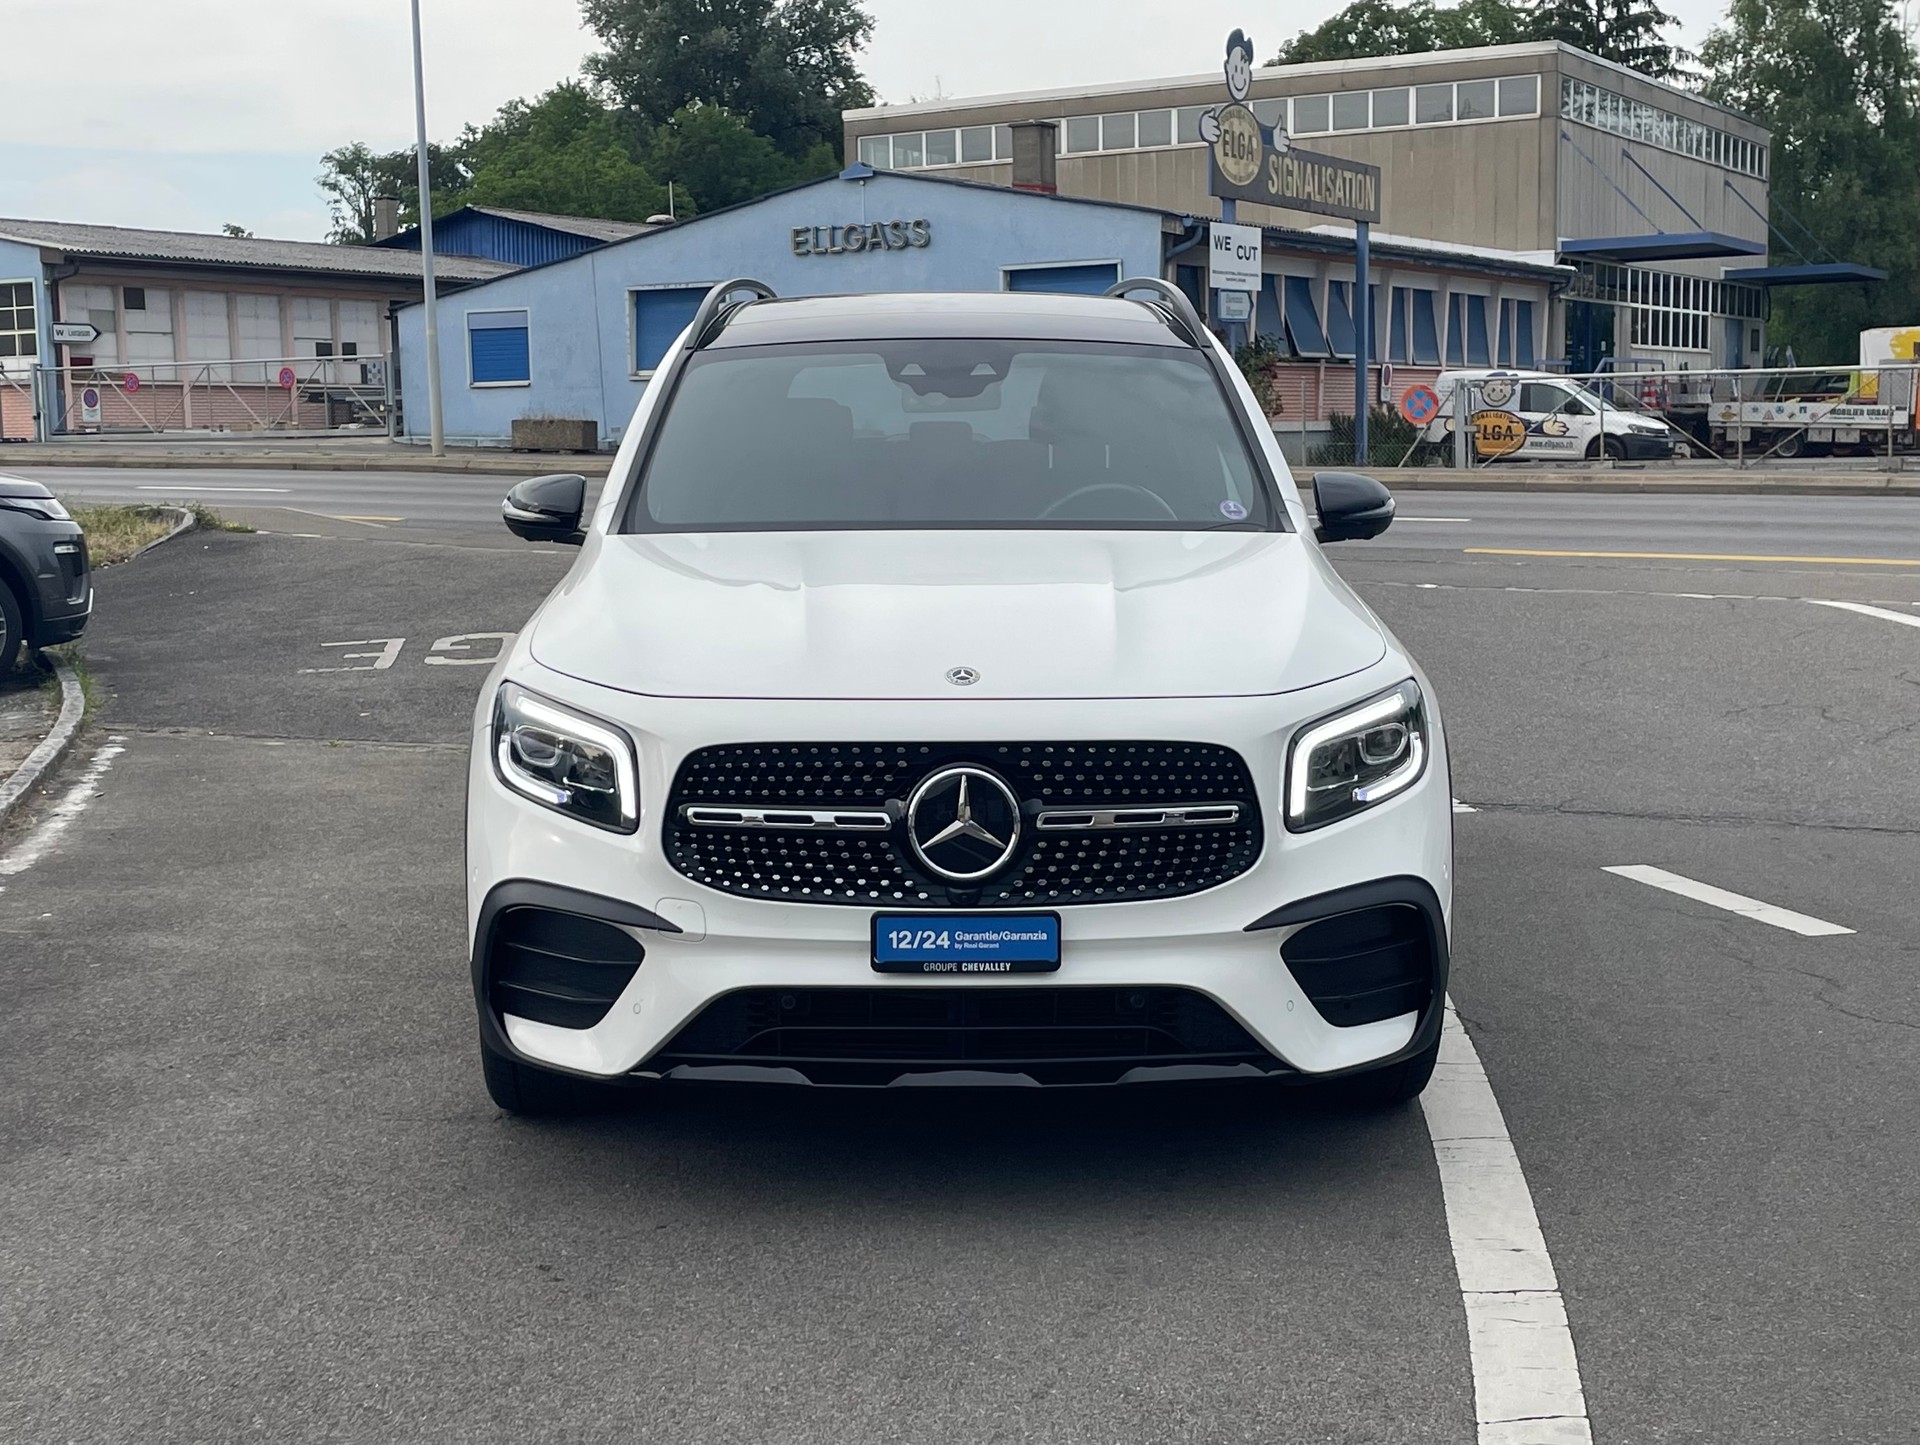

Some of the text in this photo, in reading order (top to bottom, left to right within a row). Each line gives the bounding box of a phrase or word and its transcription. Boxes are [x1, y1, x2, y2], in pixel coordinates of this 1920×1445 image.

[1223, 129, 1254, 162] ELGA
[1268, 154, 1375, 212] SIGNALISATION
[791, 219, 931, 255] ELLGASS
[1213, 234, 1258, 261] WE CUT
[888, 930, 1048, 950] 12/24 Garantie/Garanzia
[954, 942, 962, 950] by
[923, 962, 1011, 972] GROUPE CHEVALLEY
